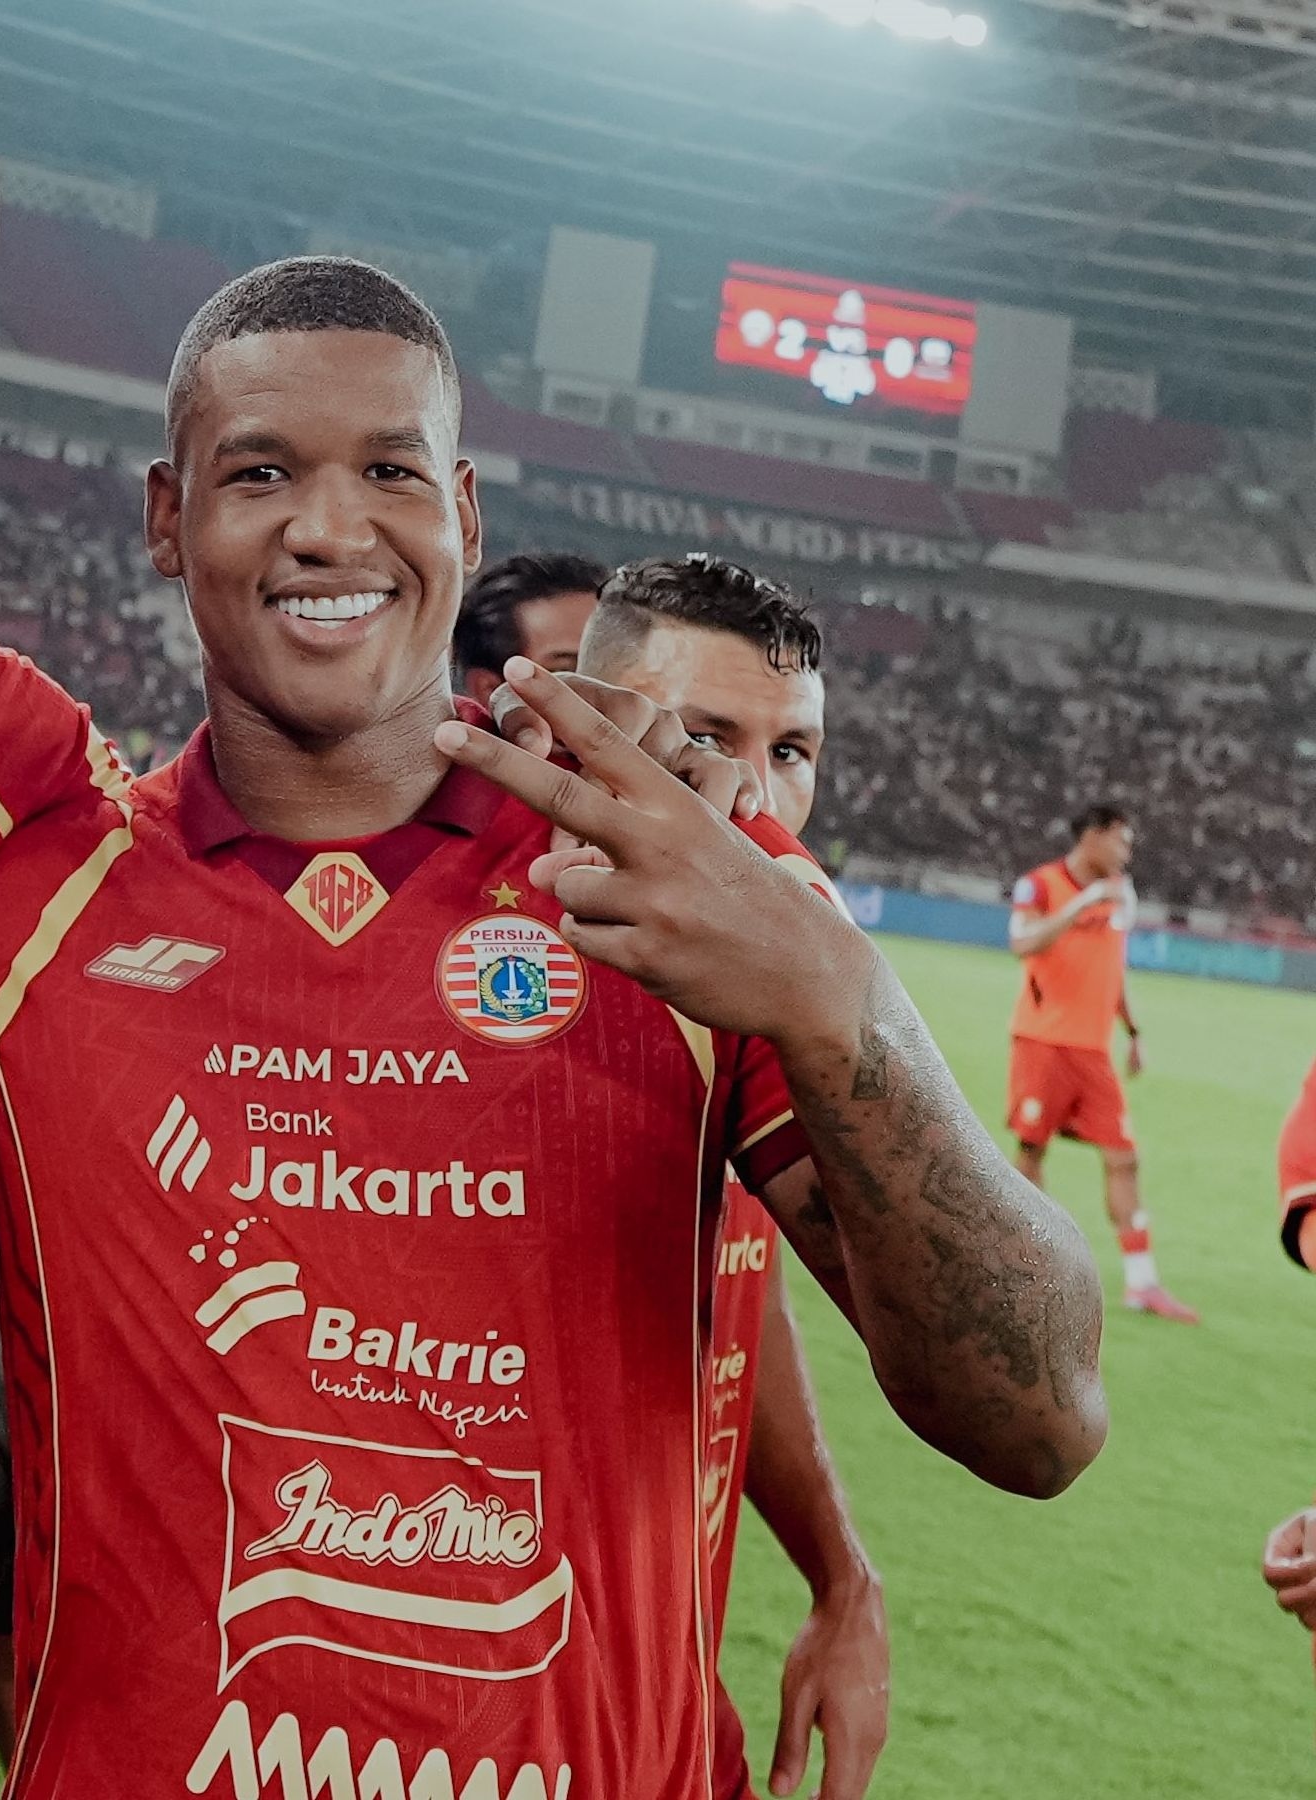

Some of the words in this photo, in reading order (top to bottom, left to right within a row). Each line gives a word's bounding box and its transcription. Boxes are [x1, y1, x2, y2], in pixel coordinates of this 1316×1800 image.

[774, 318, 807, 361] 2
[885, 337, 915, 379] 0
[302, 863, 374, 934] 1928
[470, 929, 548, 942] PERSIJA
[483, 945, 508, 954] JAYA
[512, 945, 539, 954] RAYA
[230, 1044, 332, 1082] PAM
[345, 1050, 470, 1085] JAYA
[245, 1103, 333, 1136] Bank
[229, 1146, 526, 1218] Jakarta
[307, 1306, 526, 1386] Bakrie
[311, 1369, 412, 1404] Untuk
[418, 1390, 528, 1439] Negeri
